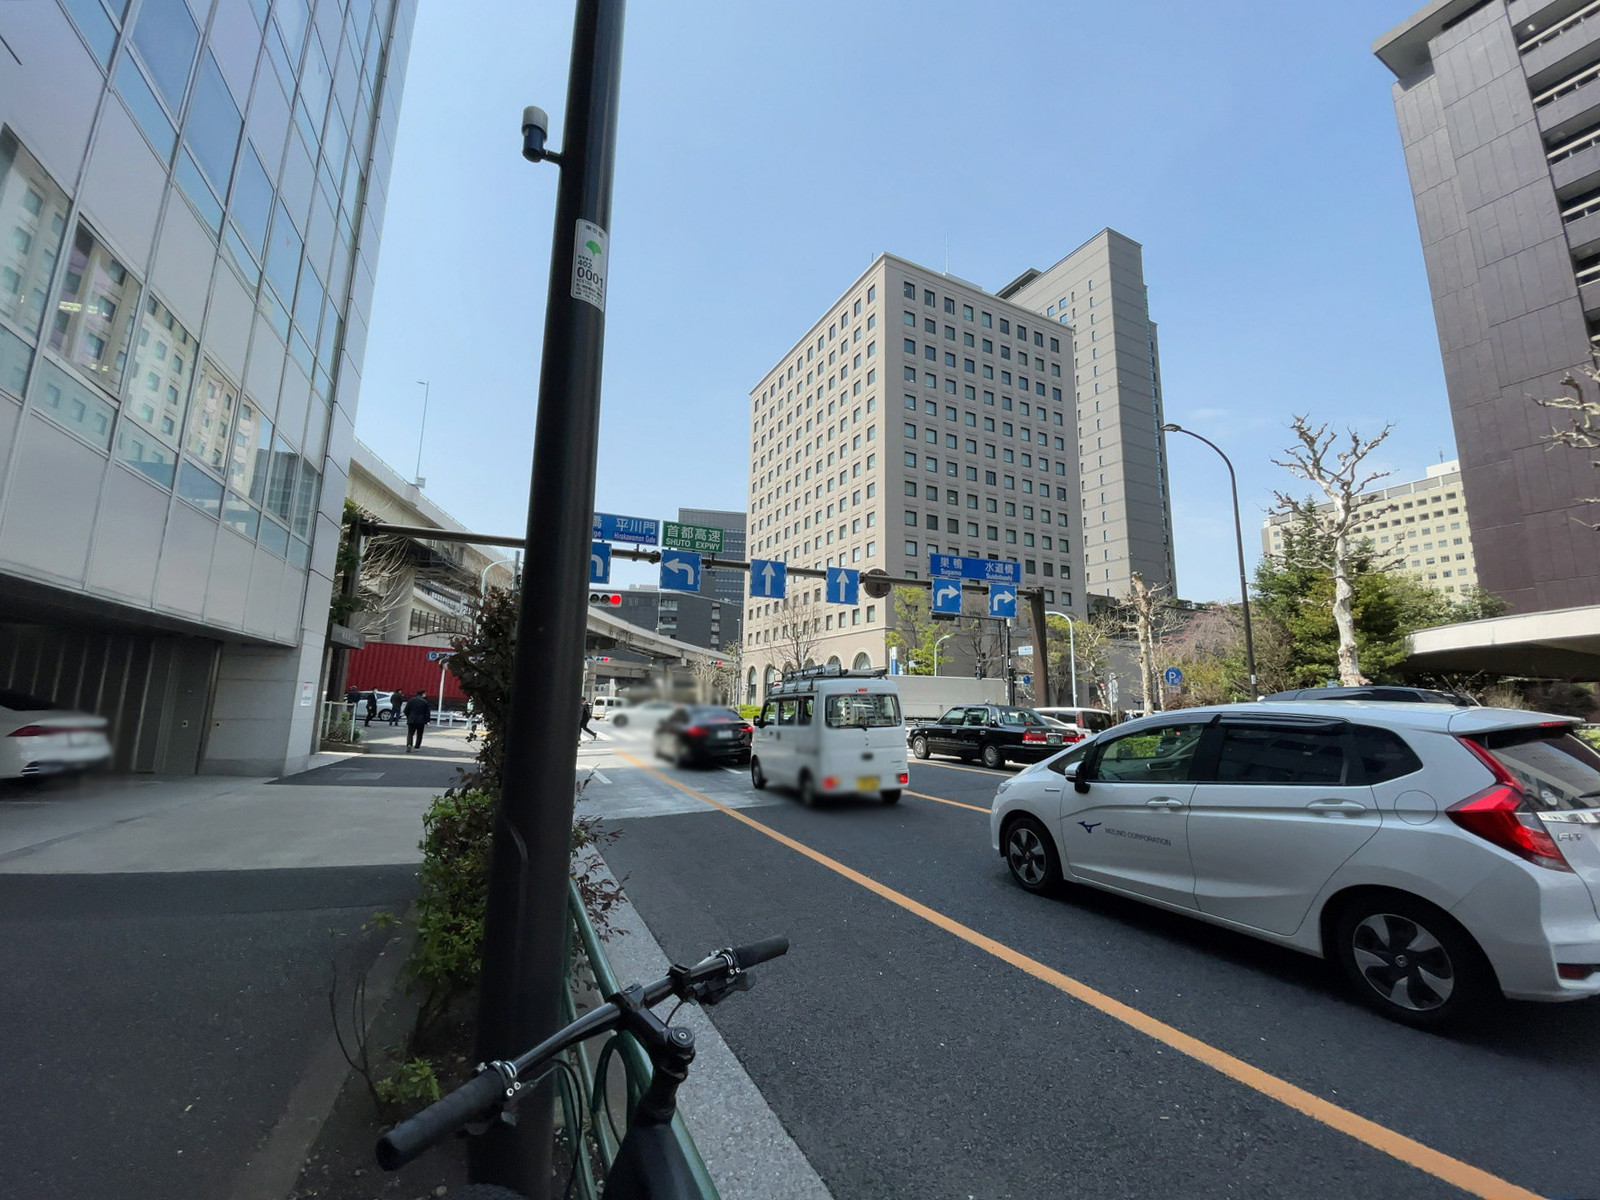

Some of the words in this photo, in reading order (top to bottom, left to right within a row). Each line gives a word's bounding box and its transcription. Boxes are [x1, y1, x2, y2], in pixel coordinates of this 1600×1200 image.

[577, 267, 603, 288] 0001
[616, 518, 656, 534] 平川門
[667, 525, 720, 542] 首都高速
[666, 537, 691, 547] SHUTO
[696, 541, 720, 551] EXPWY
[941, 568, 962, 576] Sugamo
[985, 562, 1014, 574] 水道橋
[1127, 832, 1172, 846] CORPORATION
